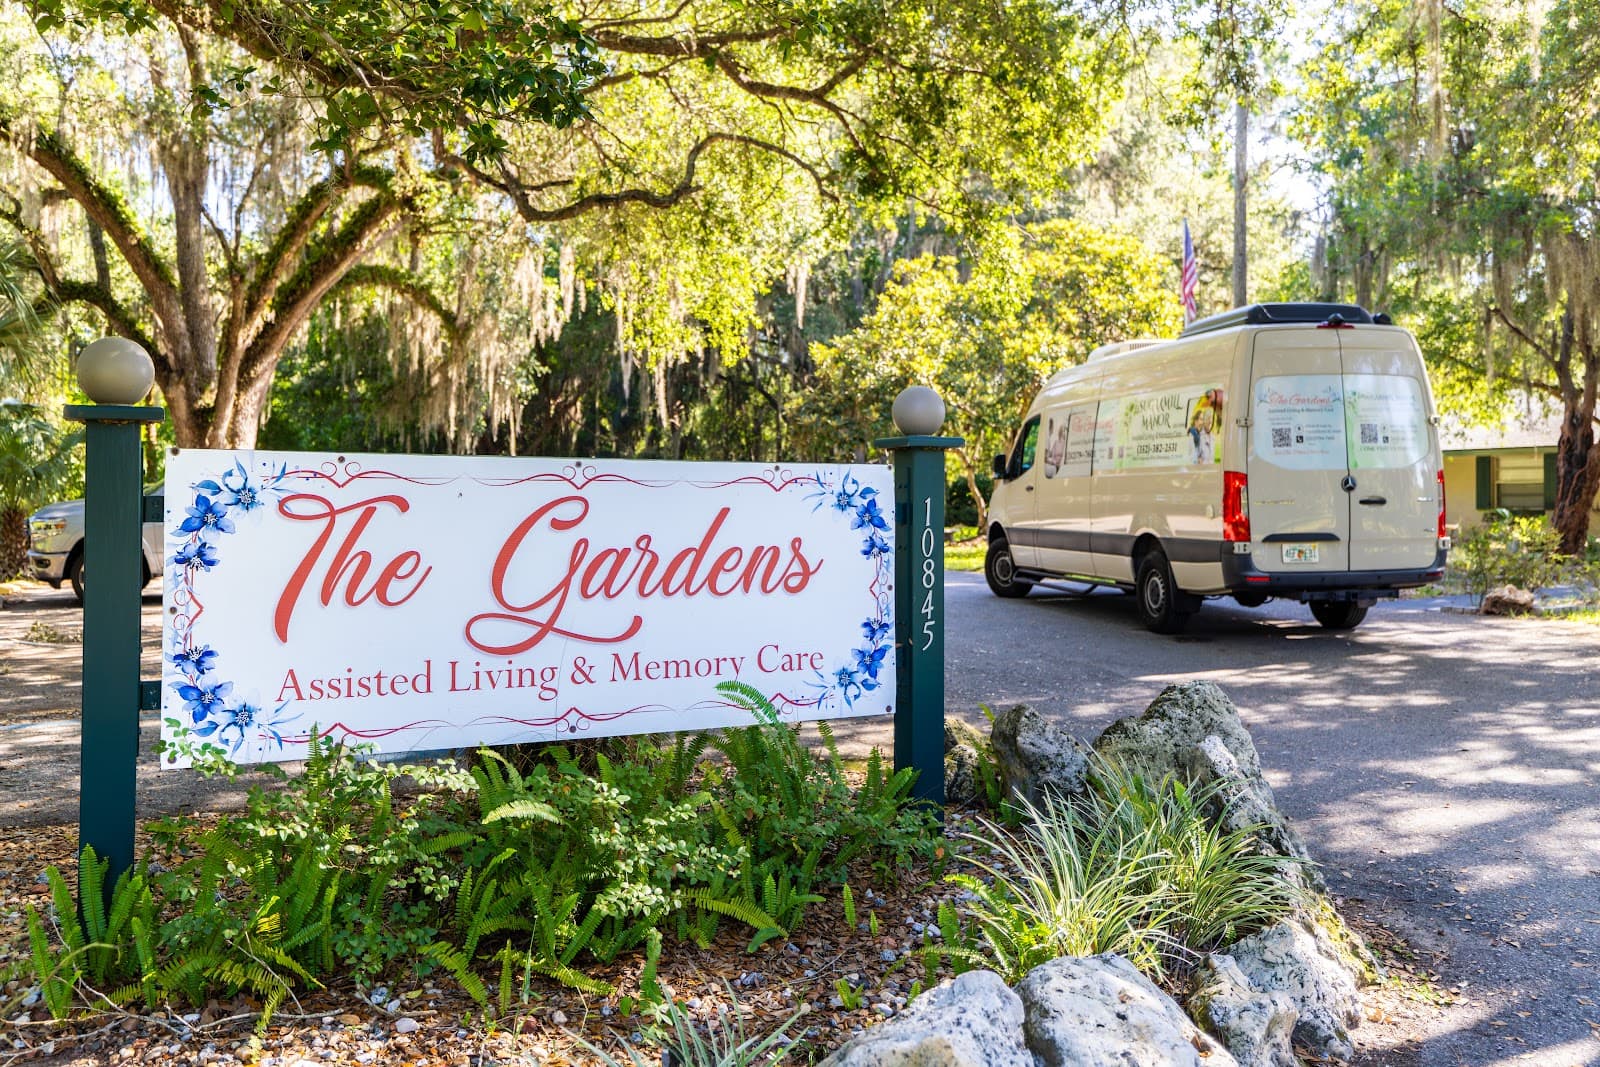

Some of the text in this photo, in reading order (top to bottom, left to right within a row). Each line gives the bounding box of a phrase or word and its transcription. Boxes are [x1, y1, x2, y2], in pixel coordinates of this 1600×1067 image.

[273, 494, 822, 656] The Gardens
[921, 497, 936, 651] 10845
[275, 643, 825, 702] Assisted Living & Memory Care
